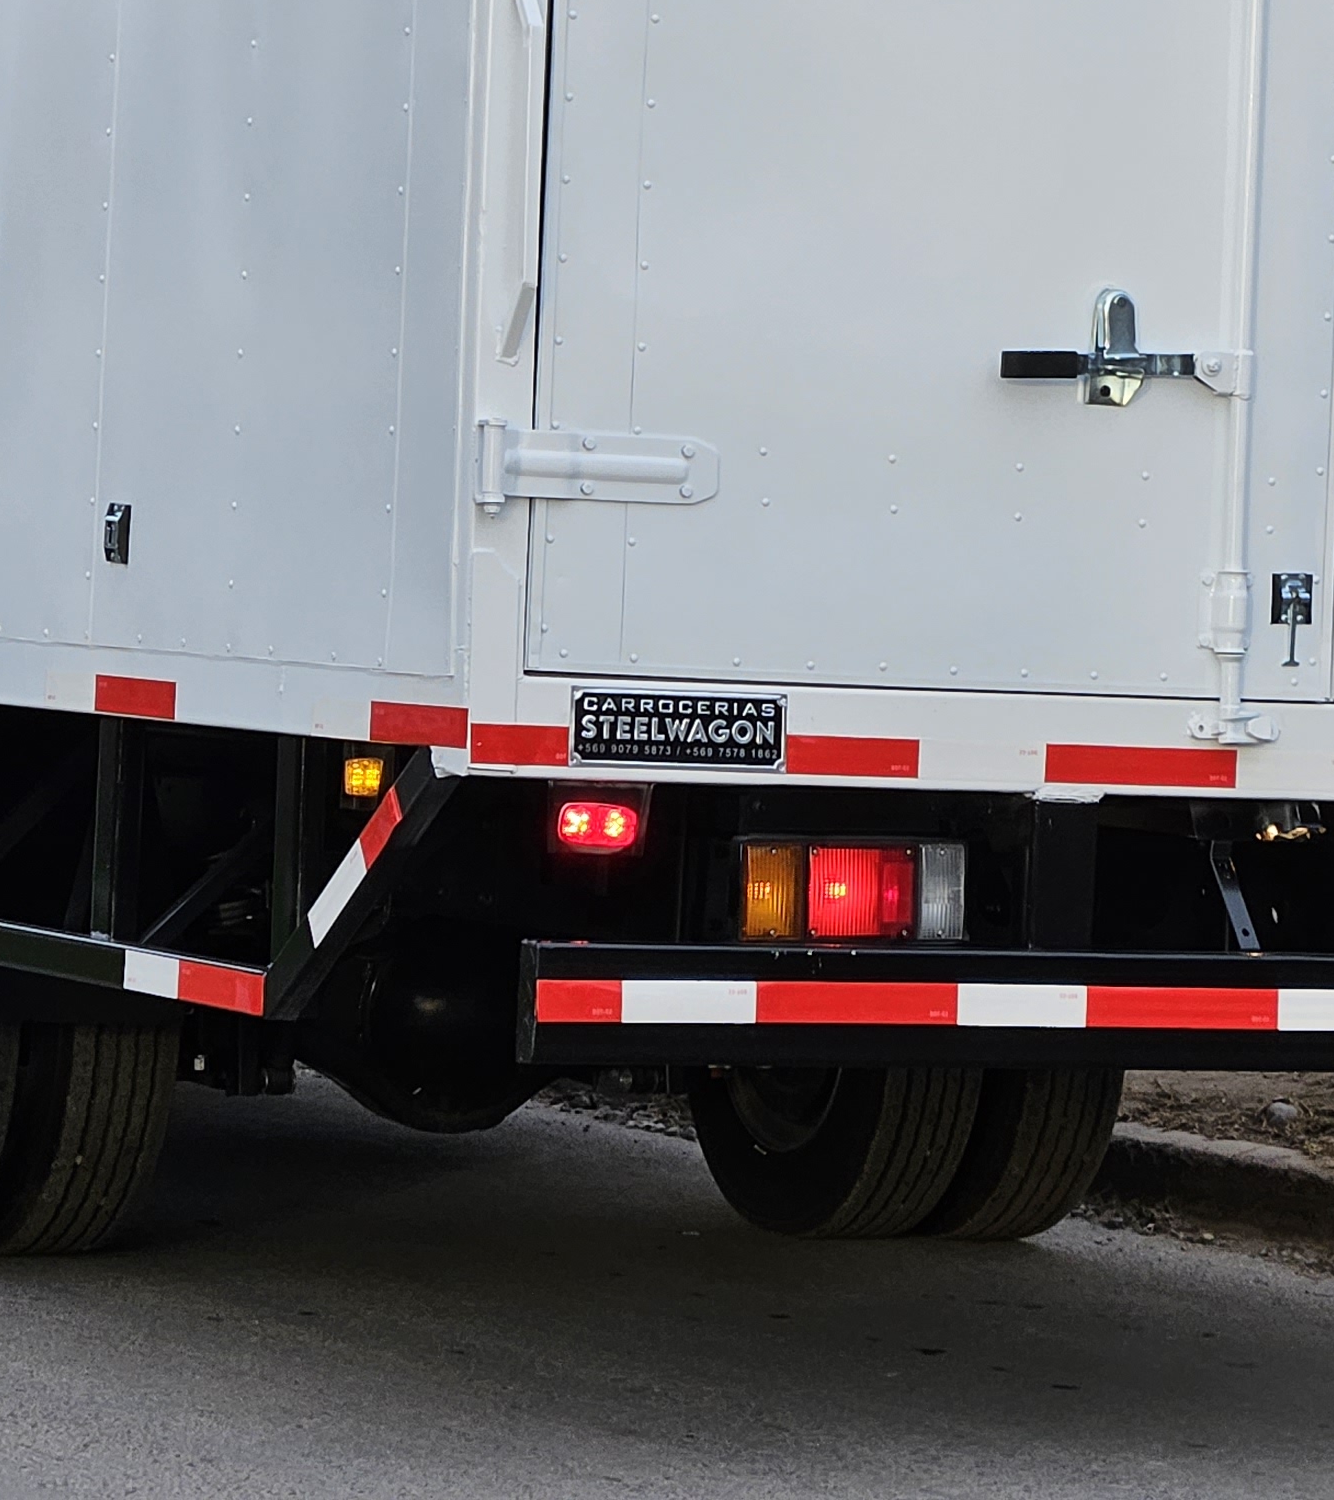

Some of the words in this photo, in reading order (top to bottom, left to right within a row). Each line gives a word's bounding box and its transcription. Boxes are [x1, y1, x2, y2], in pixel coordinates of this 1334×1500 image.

[583, 697, 775, 717] CARROCERIAS
[581, 714, 775, 745] STEELWAGON
[578, 743, 606, 754] +569
[610, 744, 639, 755] 9079
[644, 745, 672, 756] 5873
[718, 747, 746, 758] 7578
[751, 749, 778, 759] 1862
